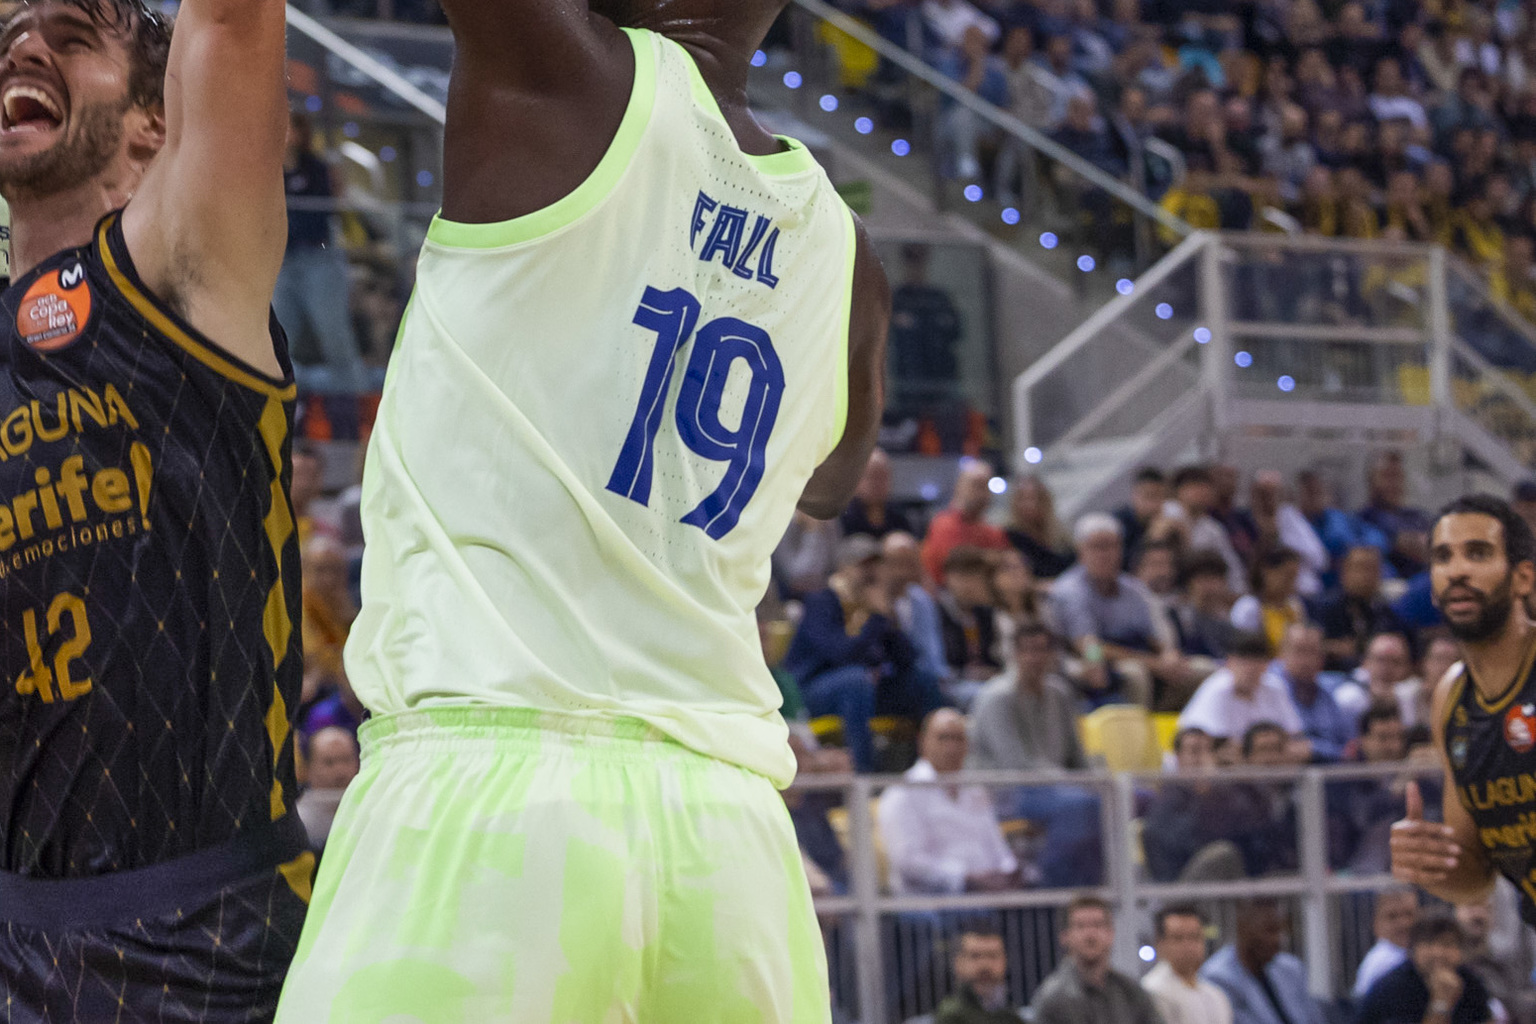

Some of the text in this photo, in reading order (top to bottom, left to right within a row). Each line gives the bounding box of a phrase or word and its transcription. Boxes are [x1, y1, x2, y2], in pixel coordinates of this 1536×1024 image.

[690, 189, 780, 290] FALL
[604, 285, 786, 541] 19
[13, 517, 137, 569] emociones
[16, 592, 92, 703] 42
